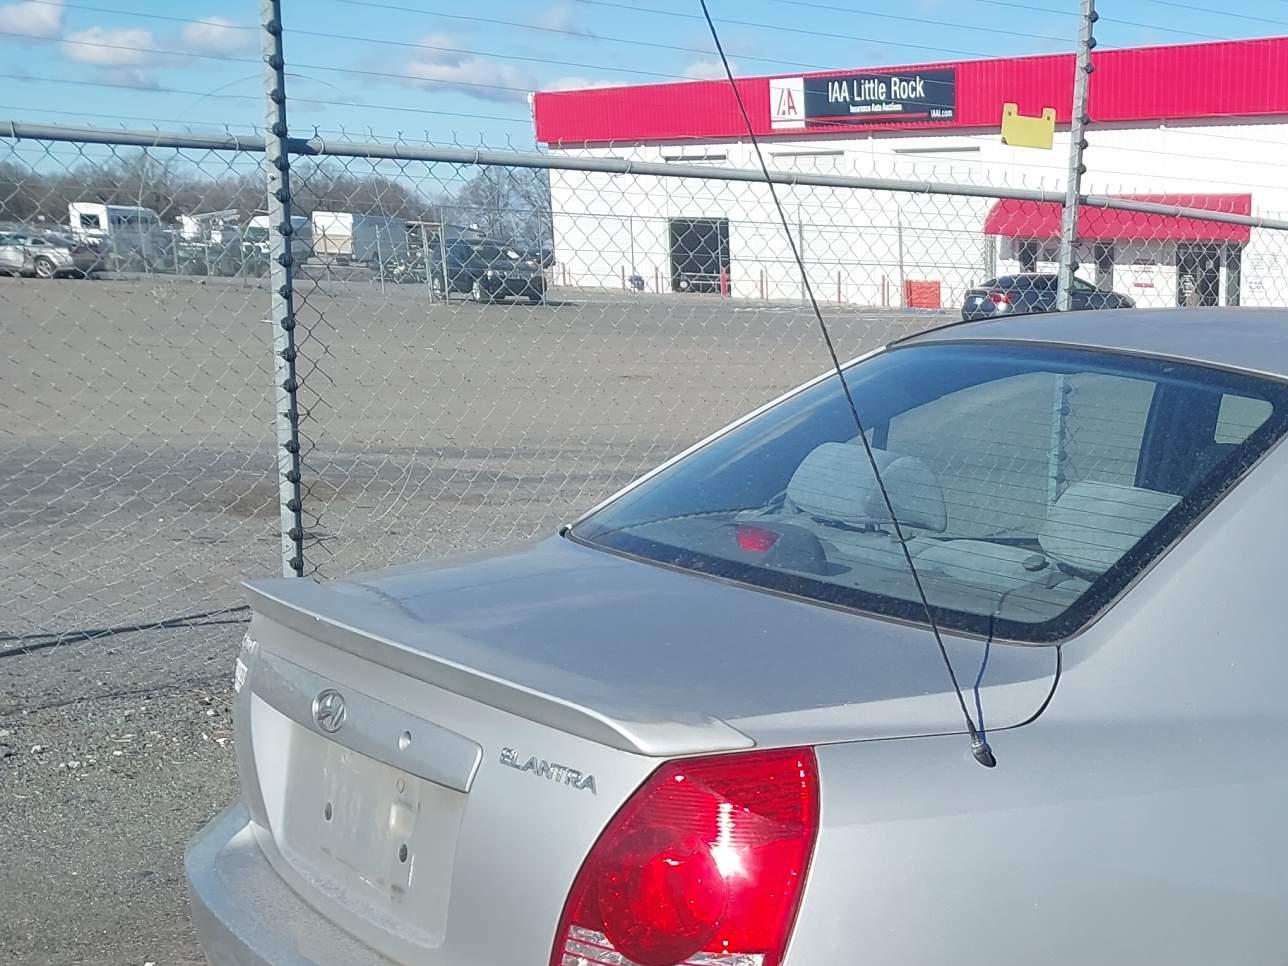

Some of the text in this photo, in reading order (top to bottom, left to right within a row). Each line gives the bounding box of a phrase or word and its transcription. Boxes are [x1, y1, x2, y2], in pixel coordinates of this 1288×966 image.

[829, 75, 925, 103] IAA Little Rock
[499, 747, 597, 795] ELANTRA
